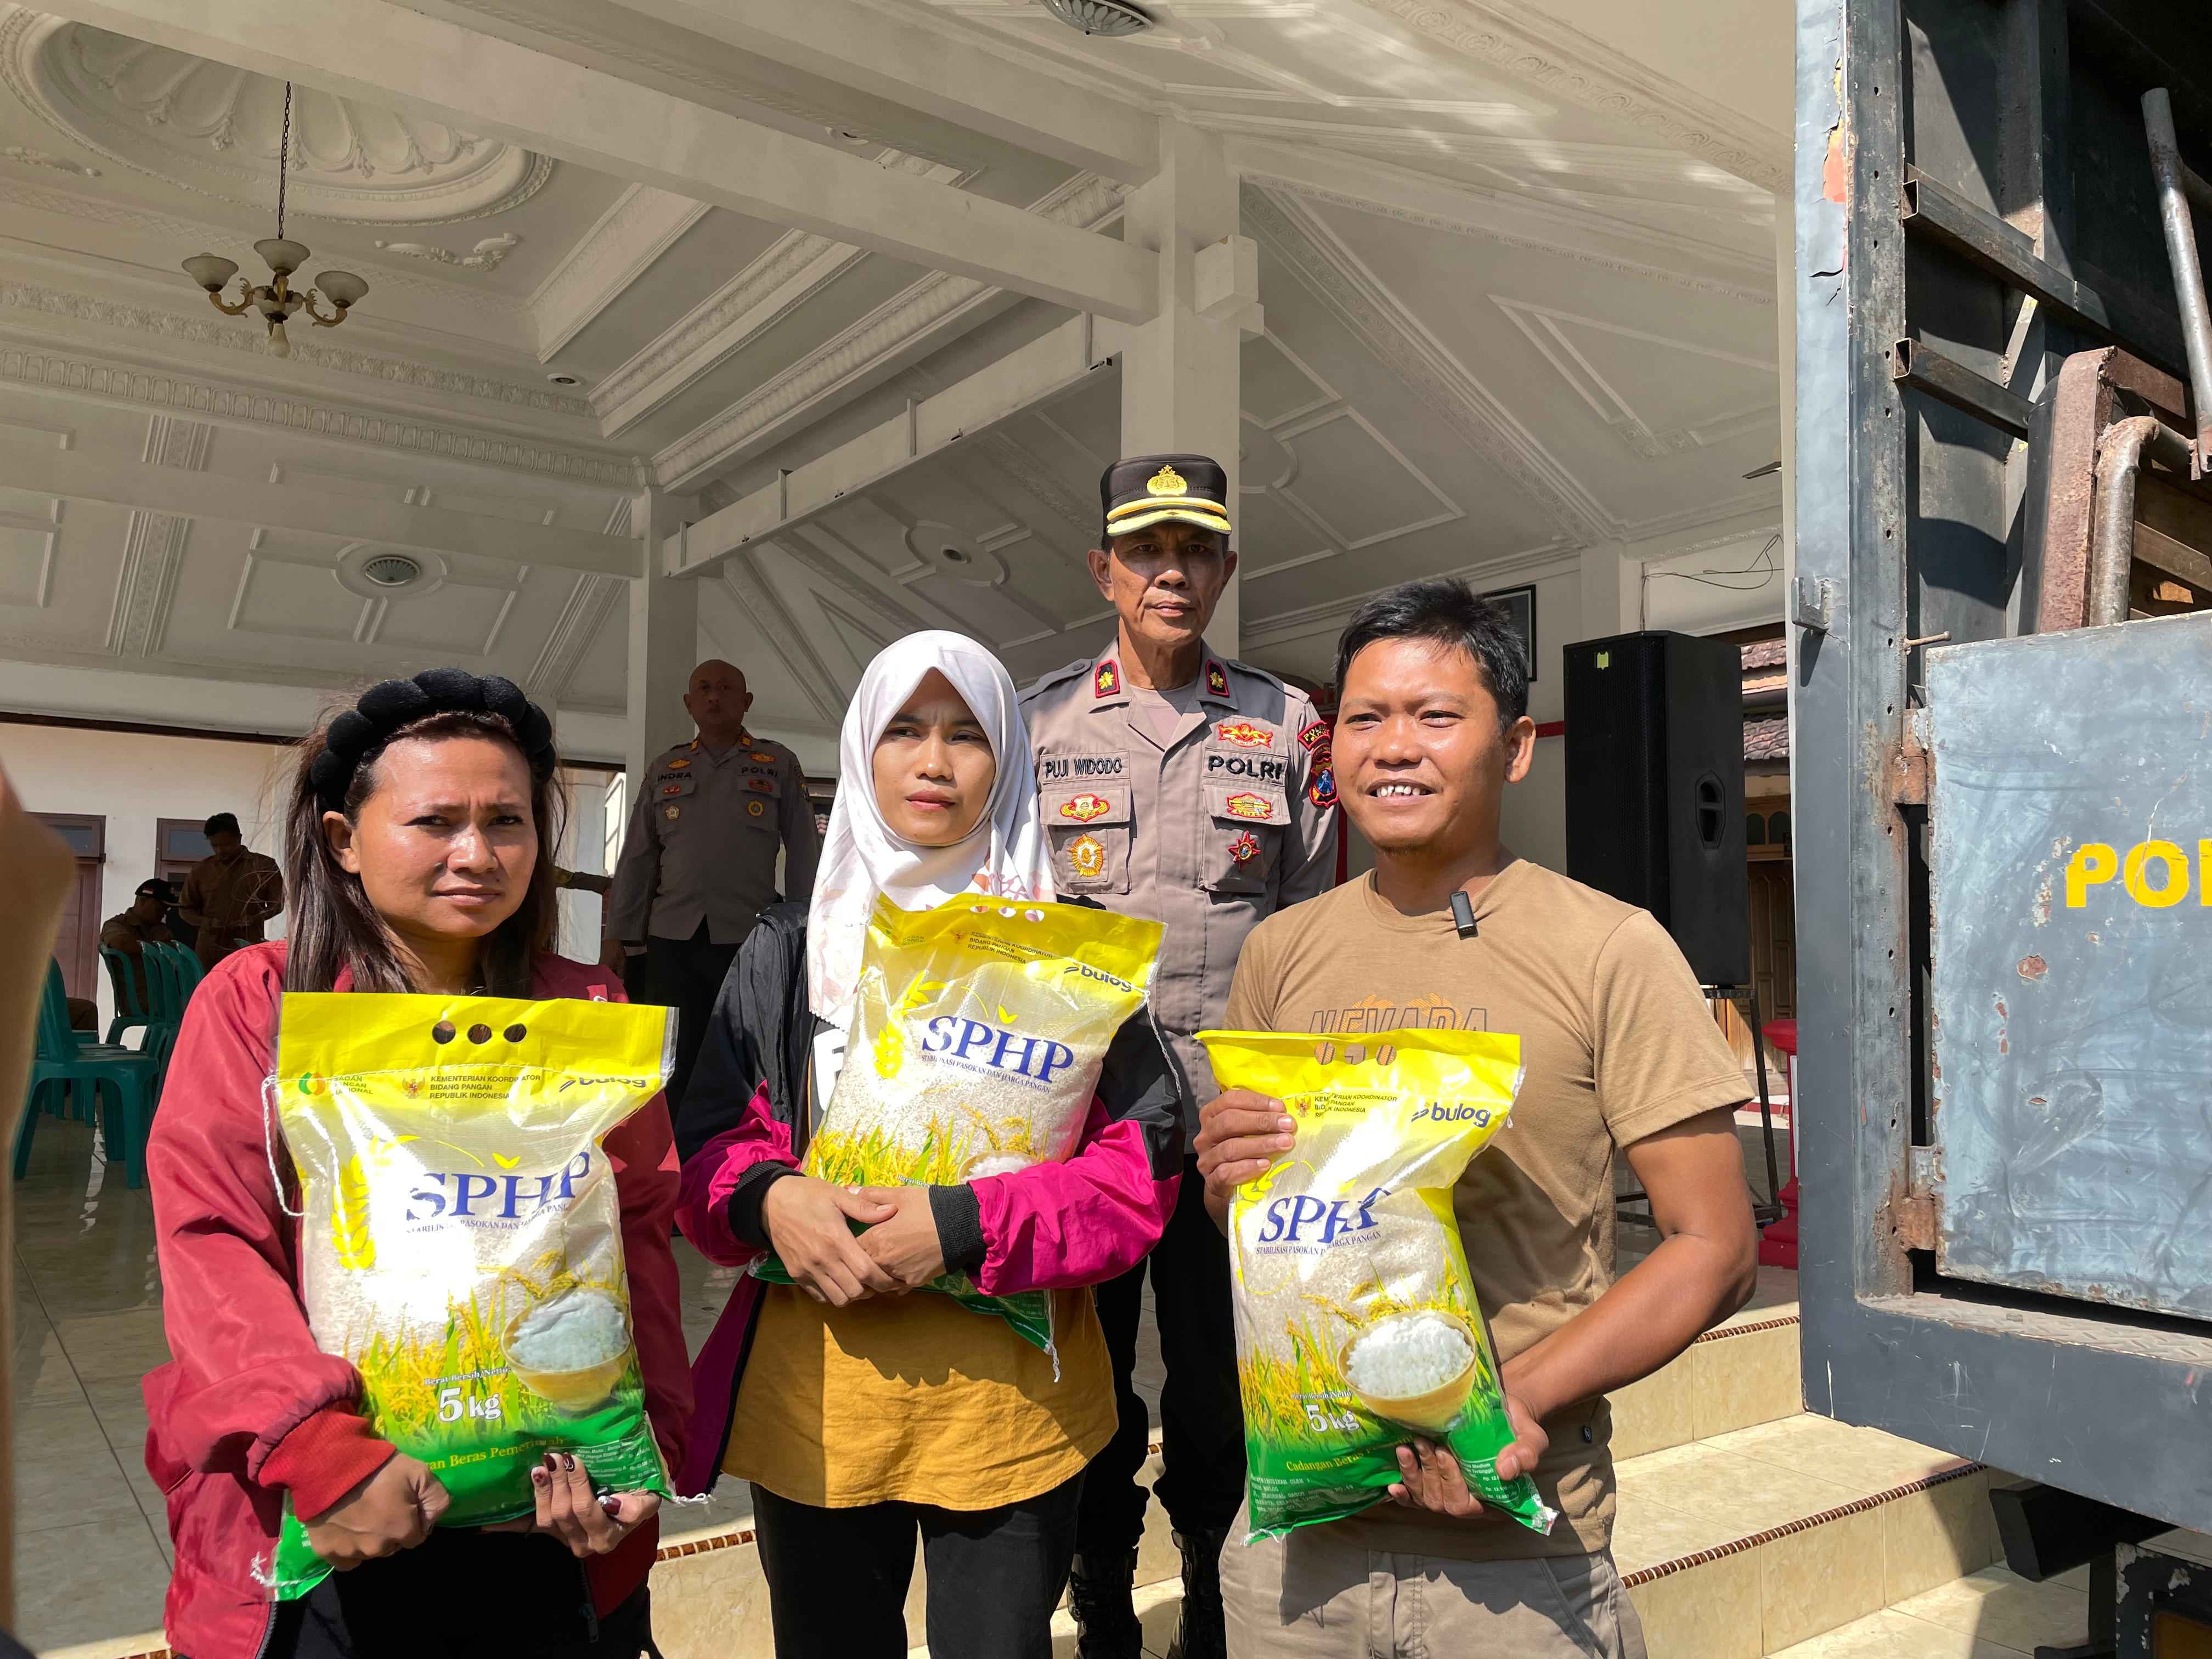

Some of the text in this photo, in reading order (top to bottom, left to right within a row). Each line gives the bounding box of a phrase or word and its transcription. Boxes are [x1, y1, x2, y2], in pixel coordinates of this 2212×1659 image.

[741, 767, 778, 777] POLRI
[1045, 757, 1122, 778] PUJI WIDODO
[1208, 755, 1282, 781] POLRI
[967, 944, 1026, 964] REPUBLIK INDONESIA
[992, 941, 1015, 953] PANGAN
[922, 1015, 1074, 1084] SPHP
[487, 1074, 541, 1083] KOORDIATOR
[987, 1070, 1001, 1078] DAN
[1001, 1073, 1024, 1086] HARGA
[1024, 1080, 1050, 1093] PANGAN
[1431, 1102, 1491, 1128] bulog
[406, 1151, 590, 1219] SPHP
[501, 1222, 519, 1230] DAN
[1256, 1246, 1288, 1255] STABILISASI
[1351, 1230, 1381, 1245] PANGAN
[424, 1377, 448, 1385] Berat
[438, 1386, 502, 1423] 5 kg
[1305, 1403, 1361, 1433] 5 kg
[449, 1451, 487, 1468] Beras
[1286, 1448, 1364, 1472] Cadangan Beras
